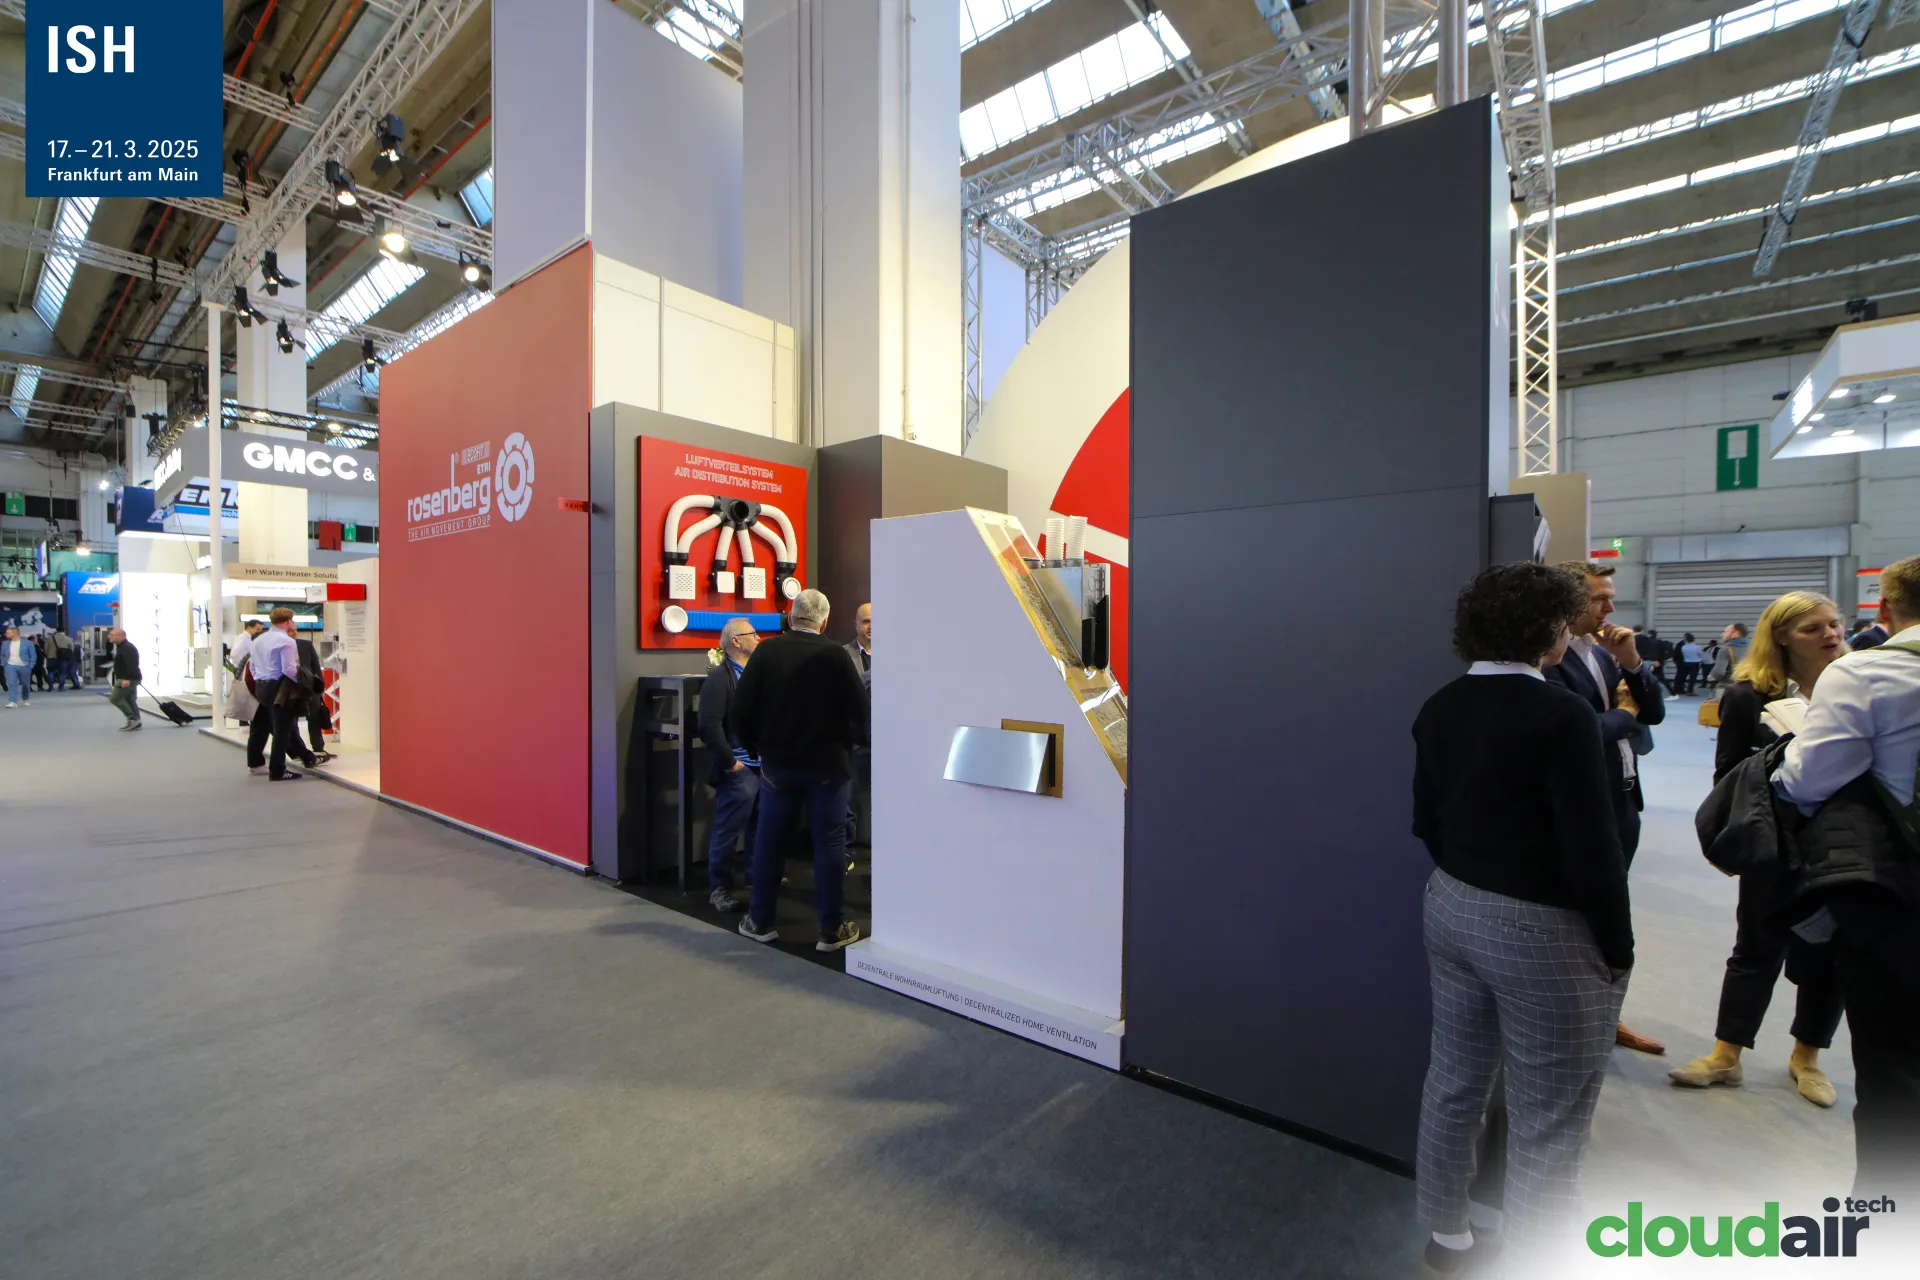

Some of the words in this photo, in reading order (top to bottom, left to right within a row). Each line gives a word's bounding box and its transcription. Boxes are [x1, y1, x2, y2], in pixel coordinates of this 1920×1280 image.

[243, 442, 358, 481] GMCC
[363, 467, 376, 482] &
[477, 461, 491, 475] ETRI
[685, 453, 774, 479] LUFTVERTEILSYSTEM
[407, 453, 491, 523] rosenberg
[674, 466, 691, 478] AIR
[692, 468, 750, 488] DISTRIBUTION
[751, 479, 782, 493] SYSTEM
[408, 530, 418, 540] THE
[420, 527, 430, 537] AIR
[431, 520, 464, 535] MOVEMENT
[467, 514, 491, 529] GROUP
[259, 569, 284, 577] Water
[857, 961, 894, 979] DEZENTRALE
[964, 997, 1021, 1023] DECENTRALIZED
[1022, 1018, 1044, 1032] HOME
[1046, 1025, 1097, 1050] VENTILATION
